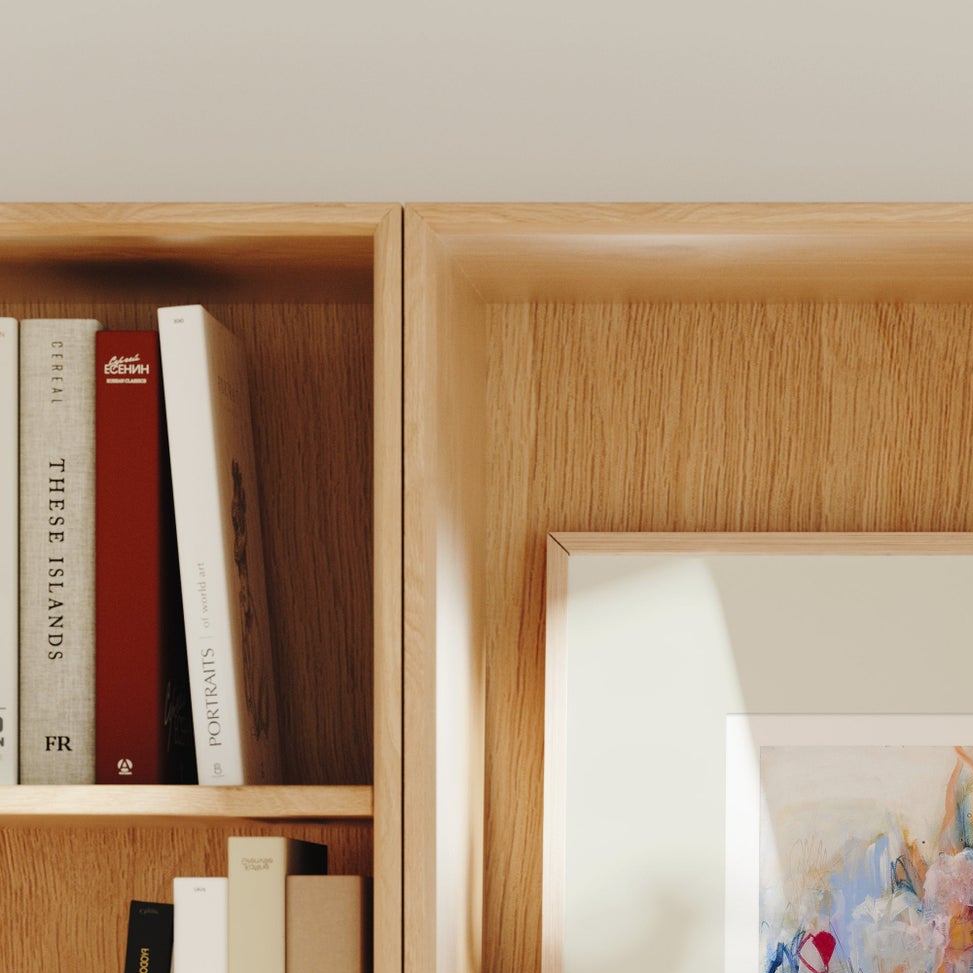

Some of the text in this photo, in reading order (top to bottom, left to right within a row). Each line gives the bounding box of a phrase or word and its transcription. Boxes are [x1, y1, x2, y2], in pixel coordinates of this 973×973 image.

[51, 341, 63, 404] CEREAL
[104, 364, 149, 374] ЕСЕНИН
[48, 458, 65, 661] THESE ISLANDS
[196, 562, 206, 577] art
[197, 580, 208, 613] world
[201, 647, 222, 747] PORTRAITS
[45, 735, 72, 752] FR
